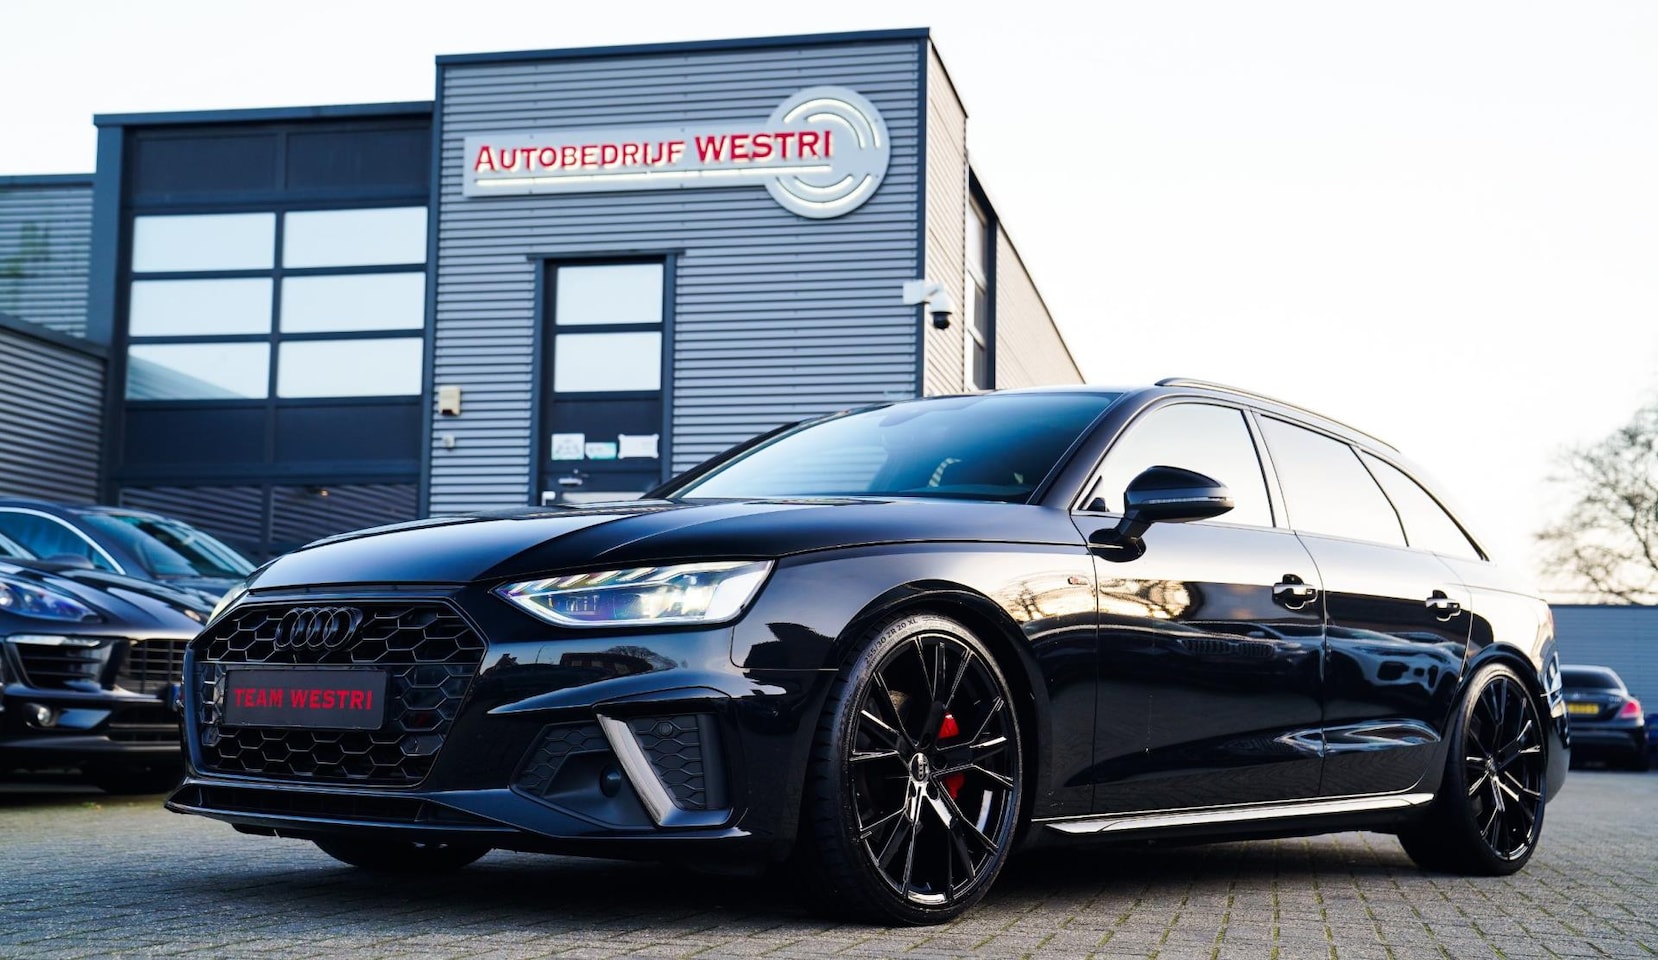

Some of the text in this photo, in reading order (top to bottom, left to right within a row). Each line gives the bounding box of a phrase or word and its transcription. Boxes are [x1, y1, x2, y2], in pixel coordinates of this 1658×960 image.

[474, 130, 832, 172] AUTOBEDRIJF WESTRI
[865, 638, 887, 664] 255/30
[886, 628, 897, 638] ZR
[897, 621, 907, 631] 20
[907, 618, 919, 626] XL
[234, 687, 373, 710] TEAM WESTRI
